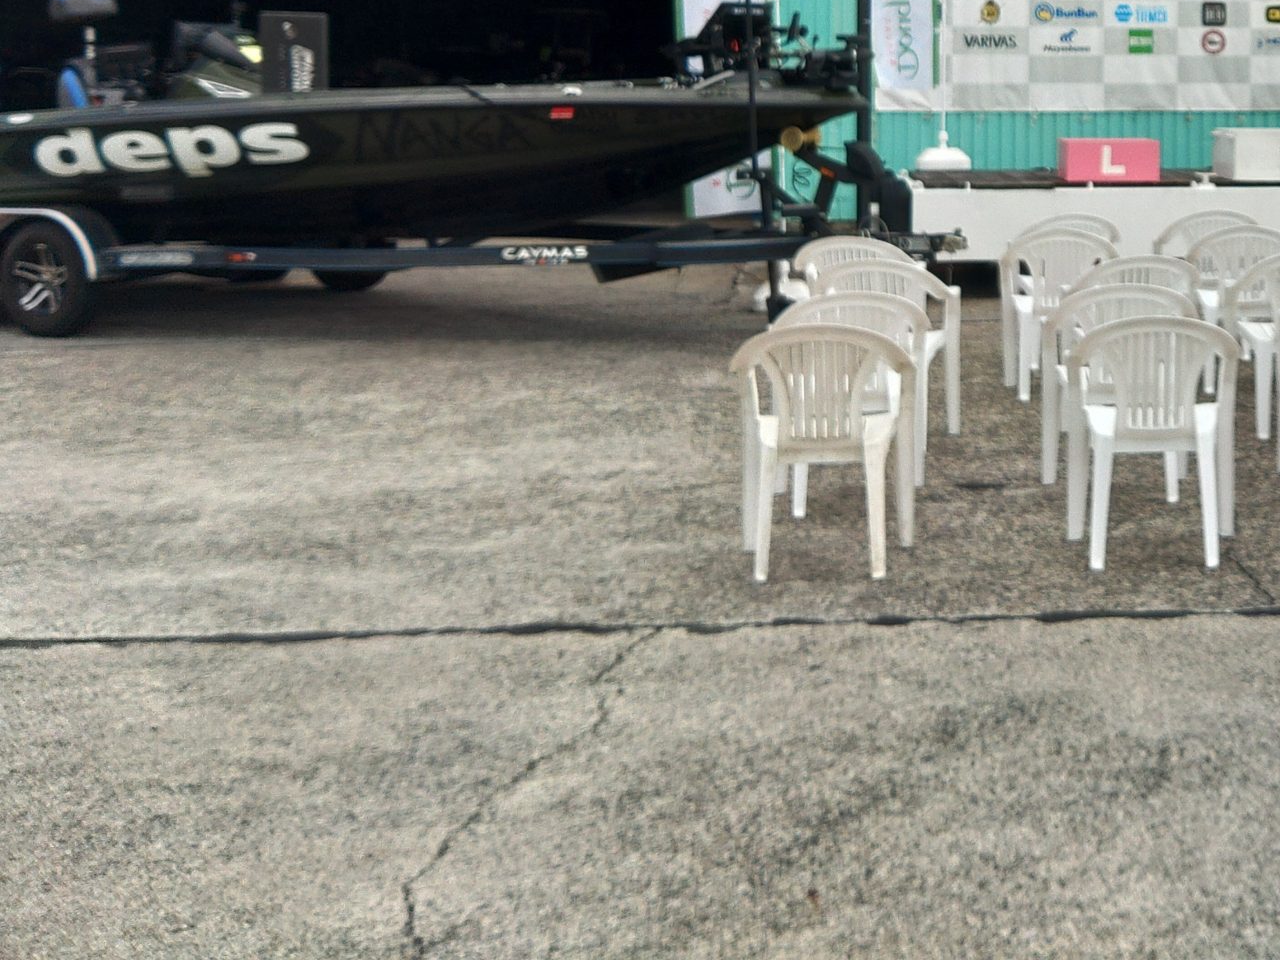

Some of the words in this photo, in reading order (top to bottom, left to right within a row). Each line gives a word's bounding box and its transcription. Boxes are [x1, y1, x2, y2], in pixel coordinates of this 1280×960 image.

[963, 33, 1018, 49] VARIVAS
[34, 121, 311, 178] deps
[1101, 143, 1127, 175] L
[501, 244, 589, 260] CAYMAS
